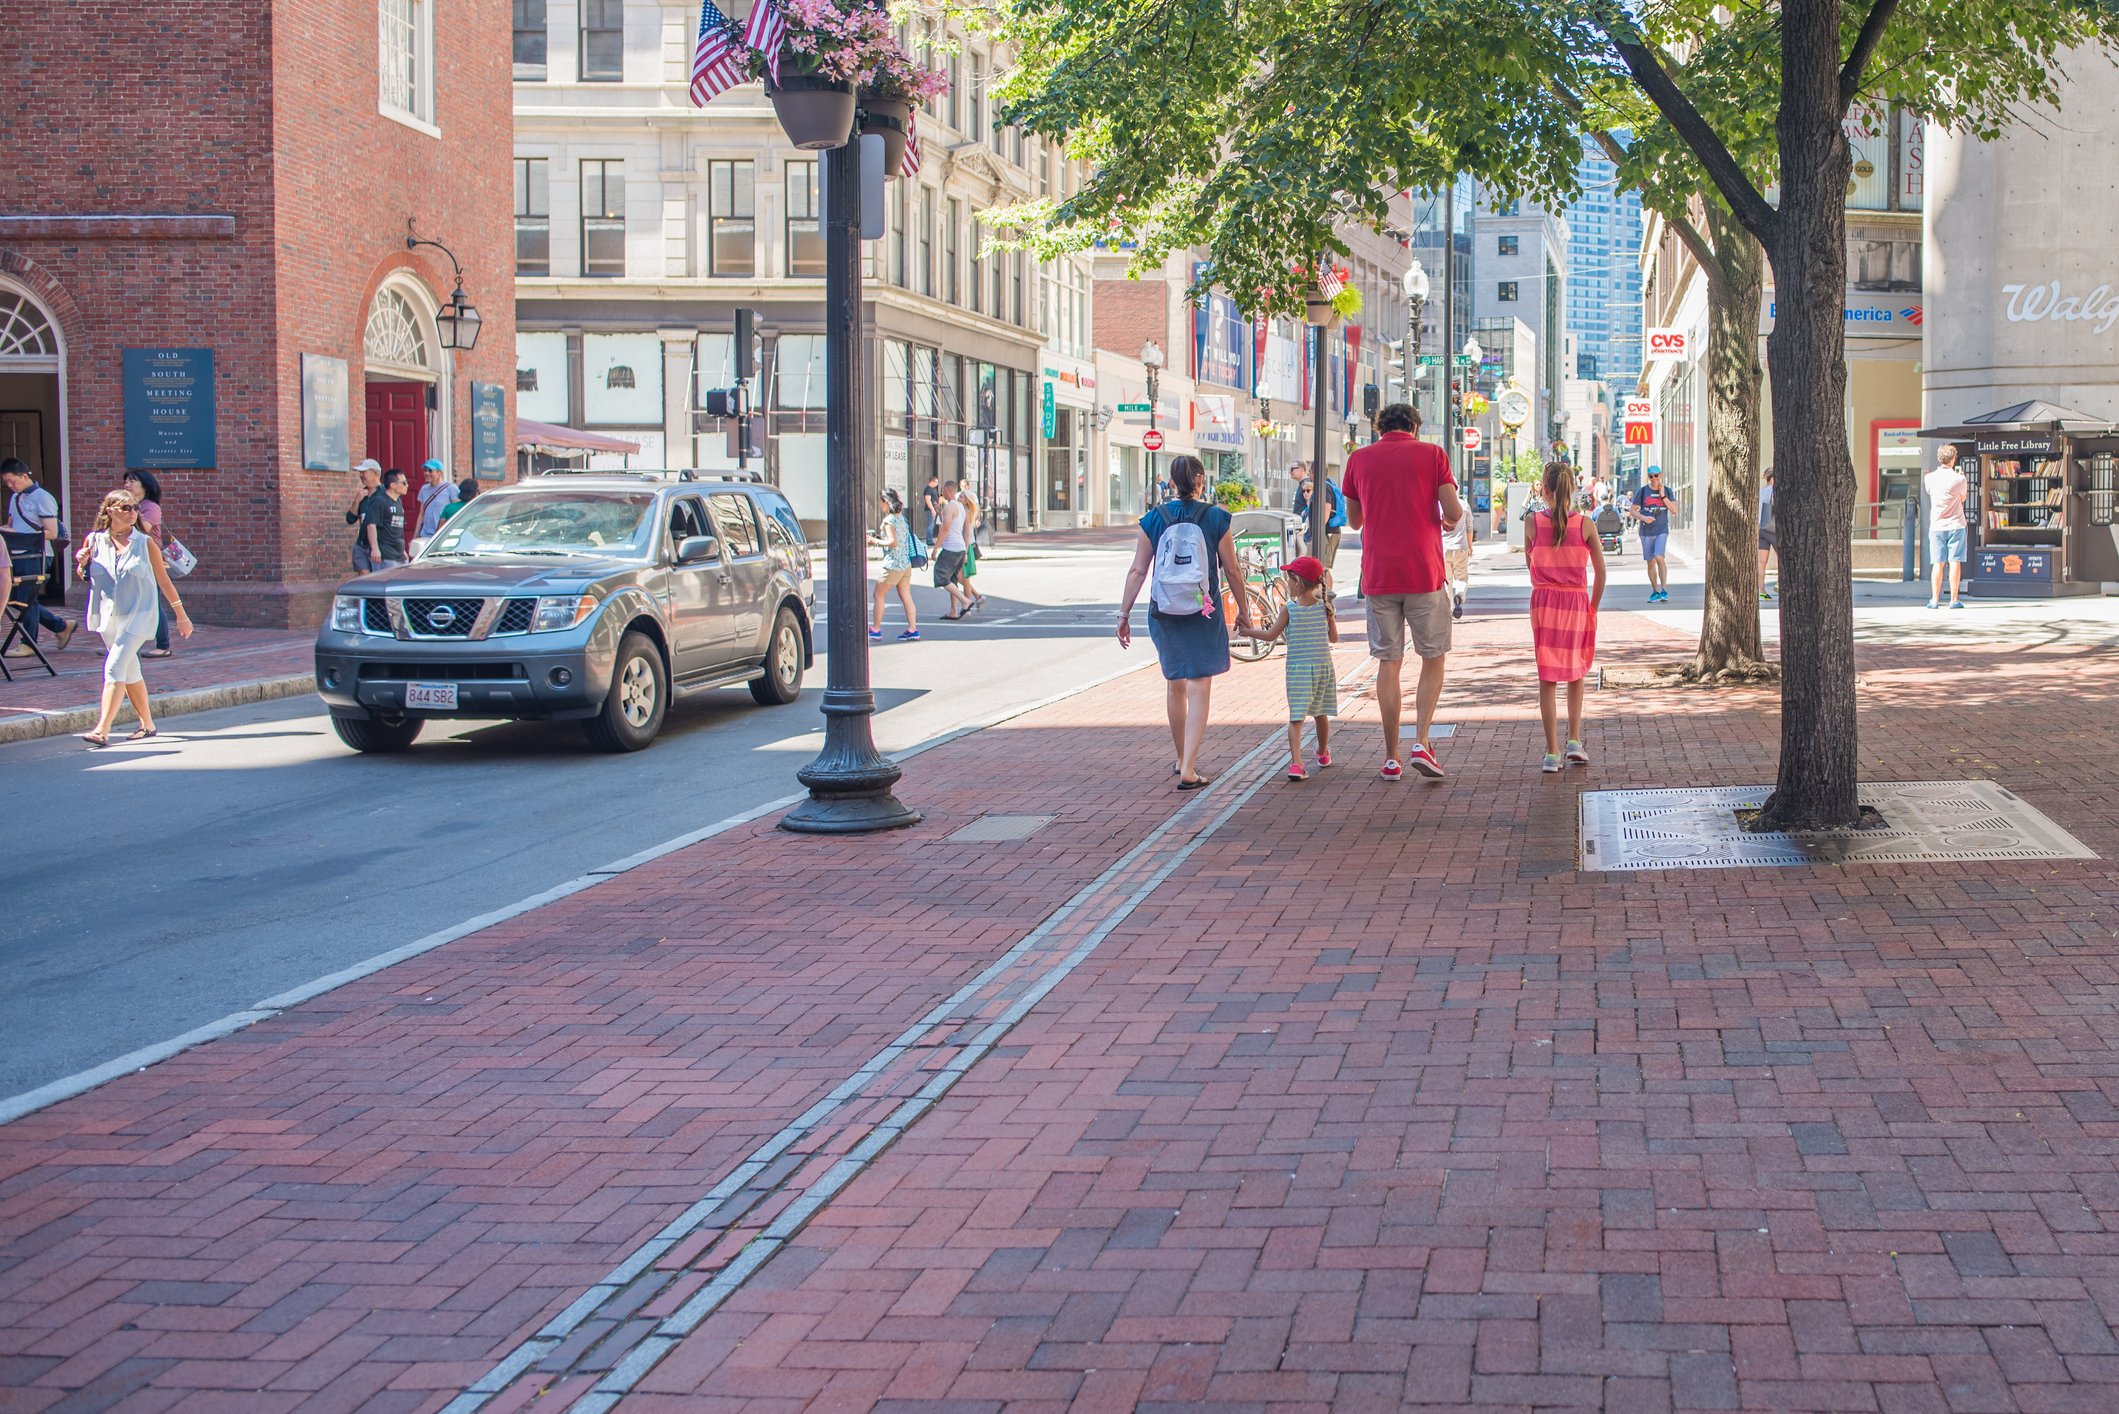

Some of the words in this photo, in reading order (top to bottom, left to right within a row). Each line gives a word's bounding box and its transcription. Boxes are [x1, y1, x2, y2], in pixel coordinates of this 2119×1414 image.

[2001, 280, 2119, 334] Walg
[1651, 334, 1685, 348] CVS
[1627, 403, 1651, 412] CVS
[1977, 441, 1999, 451] Little
[2001, 440, 2019, 450] Free
[2020, 440, 2051, 452] Library
[409, 688, 431, 702] 844
[433, 689, 454, 704] SB2
